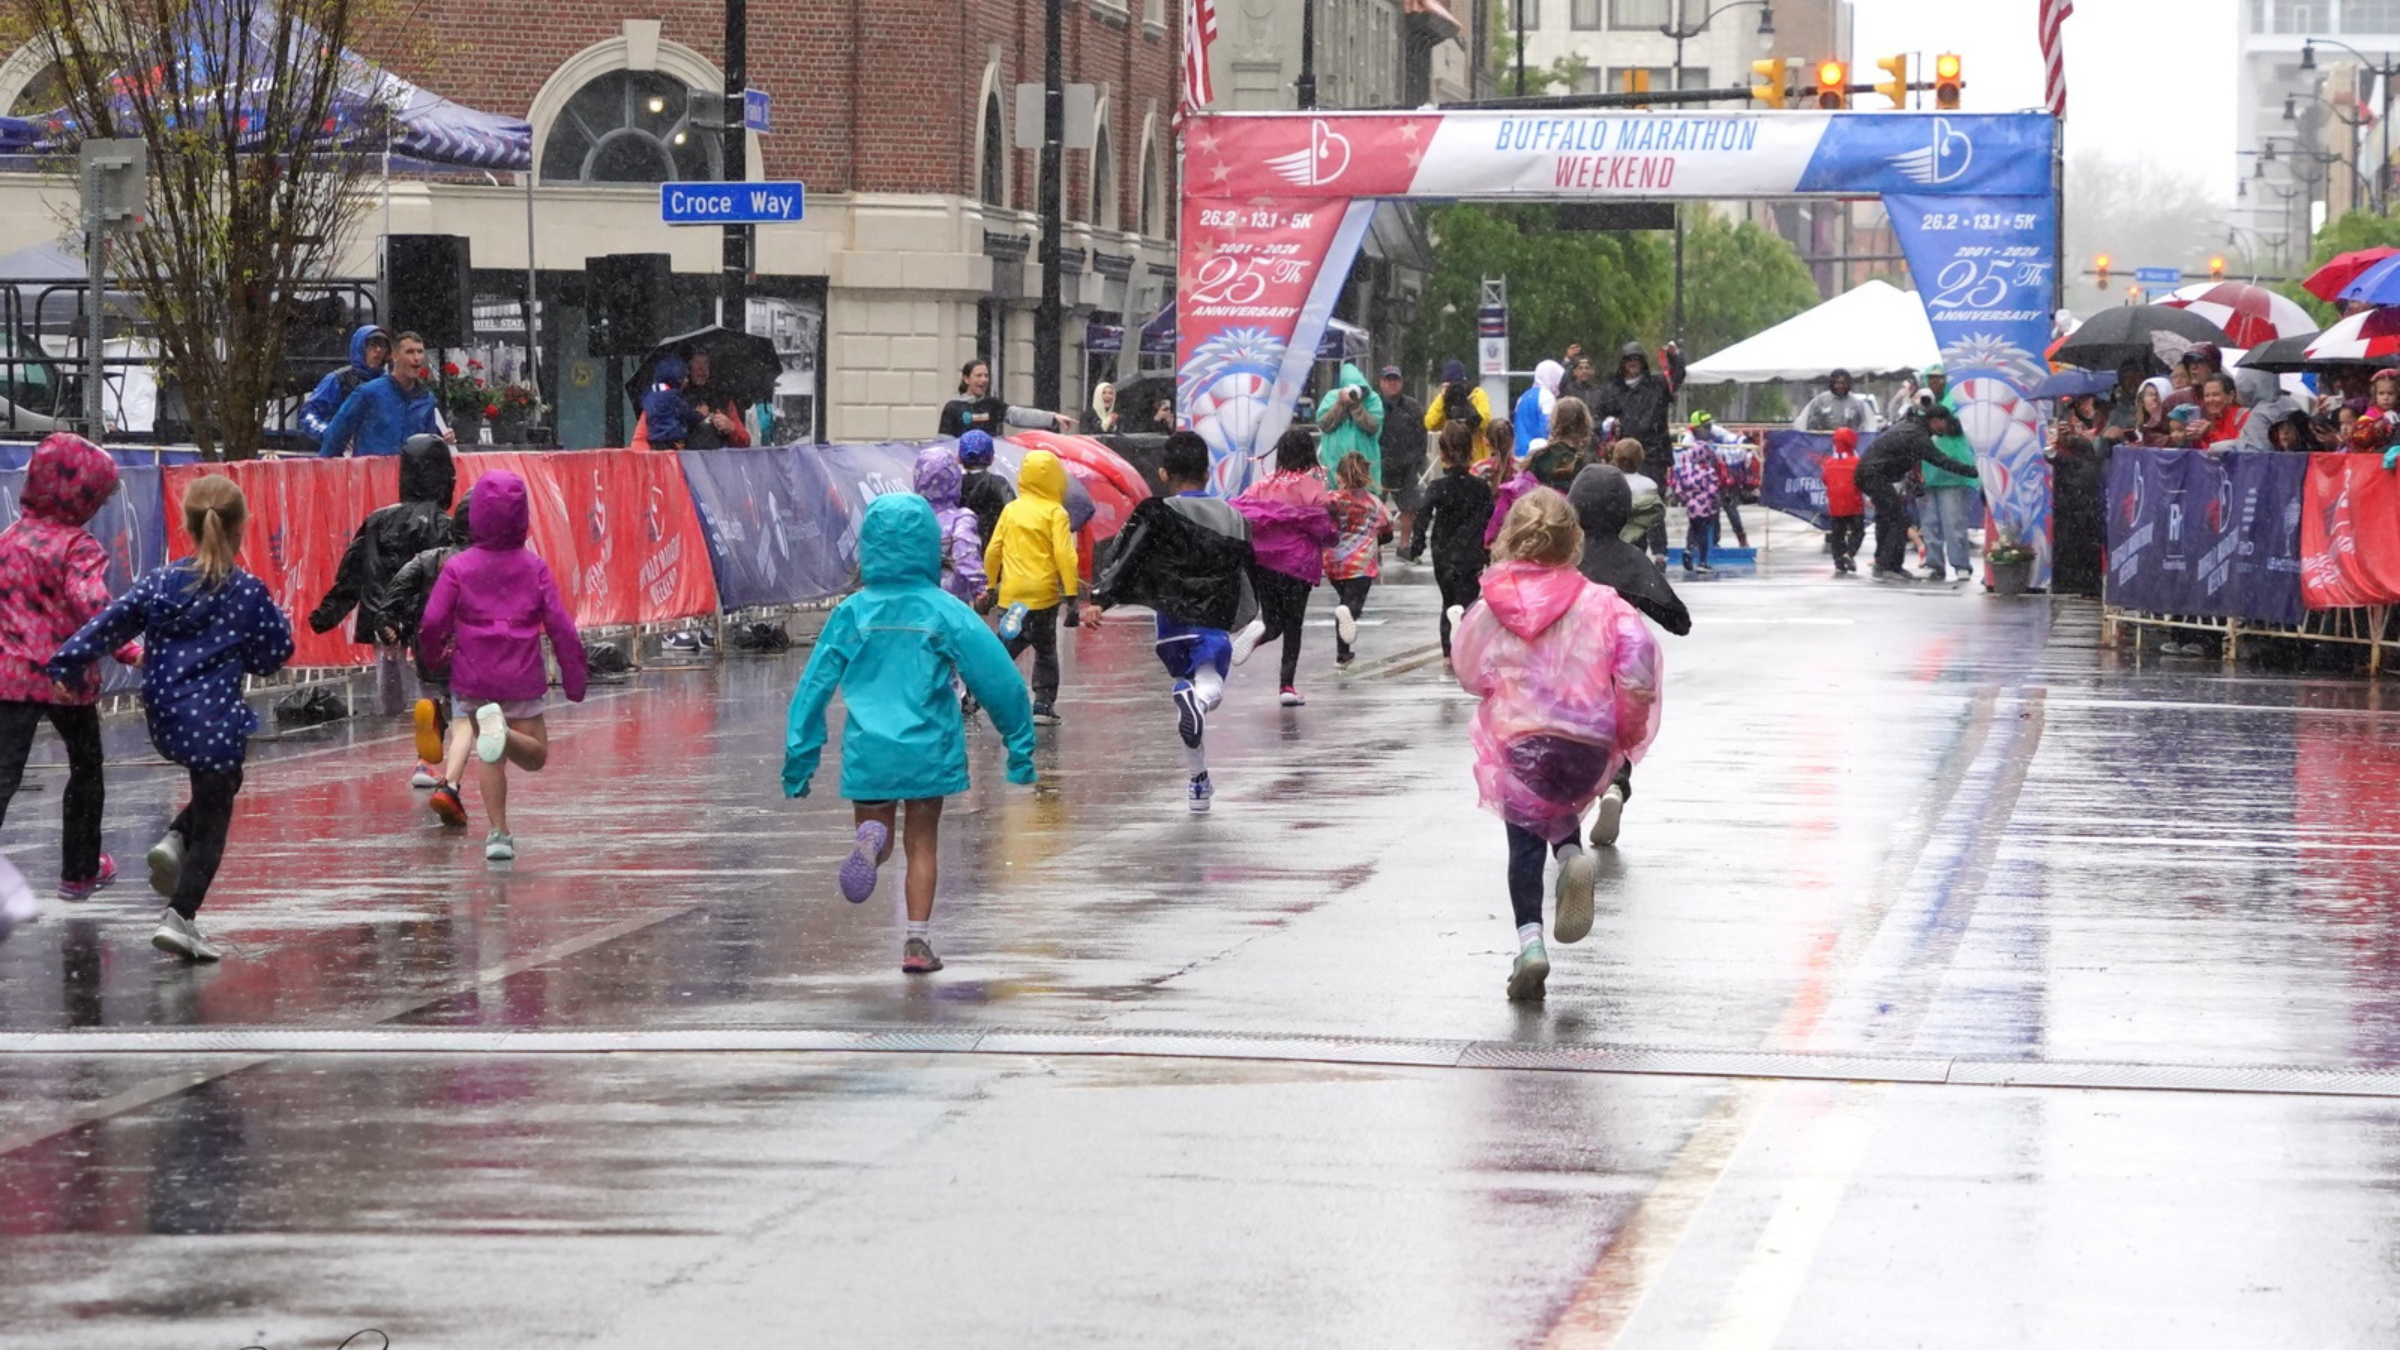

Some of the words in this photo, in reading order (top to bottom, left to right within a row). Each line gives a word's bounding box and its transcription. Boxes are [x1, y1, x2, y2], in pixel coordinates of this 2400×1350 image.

[1496, 120, 1608, 150] BUFFALO
[1615, 119, 1758, 150] MARATHON
[1555, 156, 1675, 188] WEEKEND
[671, 191, 732, 214] Croce
[750, 191, 793, 219] Way
[1199, 209, 1237, 226] 26.2
[1250, 211, 1278, 228] 13.1
[1290, 213, 1314, 229] 5K
[1921, 213, 1958, 231] 26.2
[1973, 213, 2001, 230] 13.1
[2013, 213, 2037, 230] 5K
[1190, 305, 1301, 318] ANNIVERSARY
[1931, 310, 2042, 322] ANNIVERSARY
